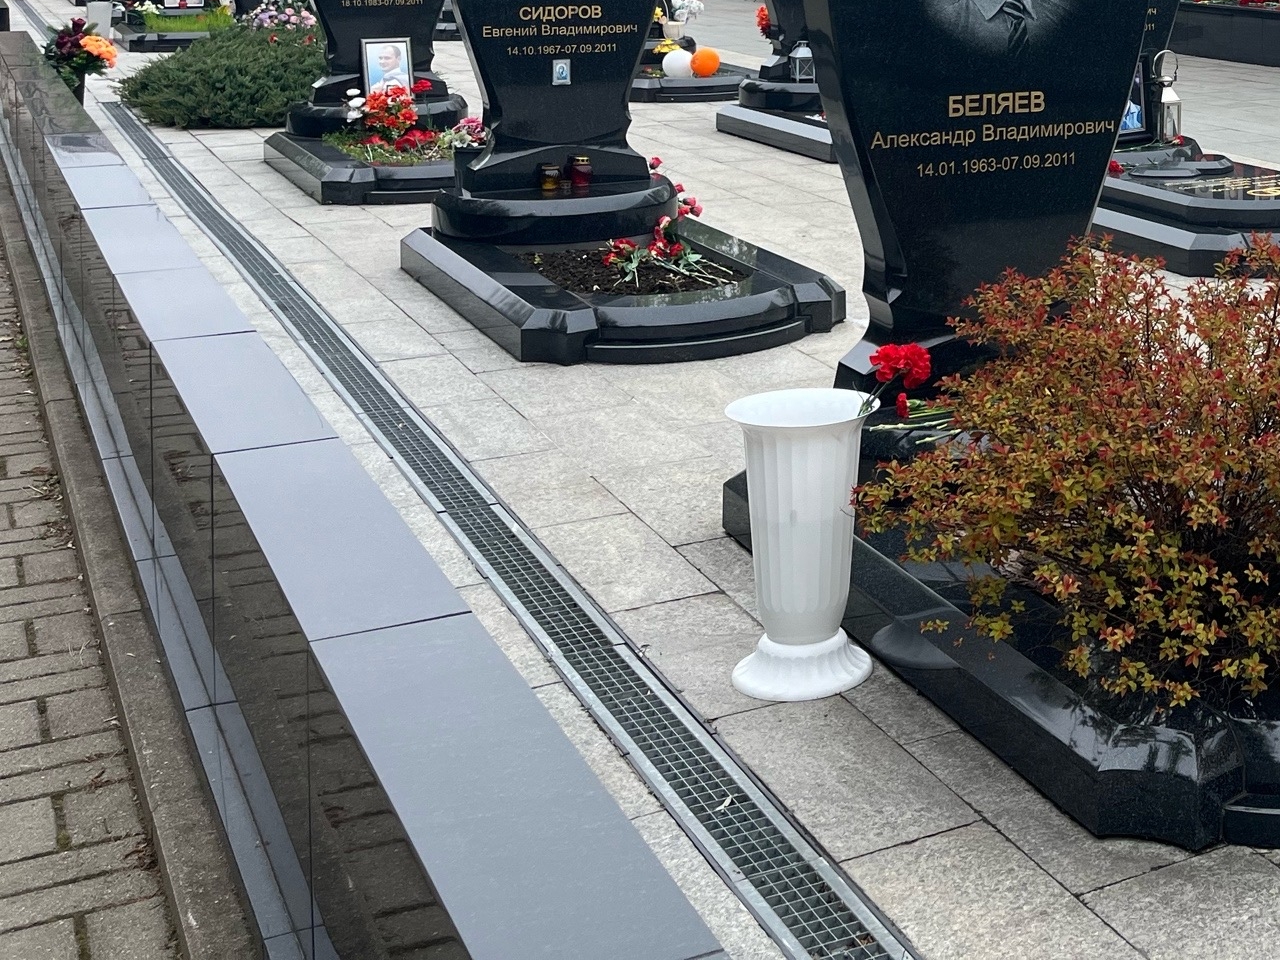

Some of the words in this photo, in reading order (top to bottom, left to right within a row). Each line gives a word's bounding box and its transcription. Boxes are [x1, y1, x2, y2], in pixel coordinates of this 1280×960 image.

[519, 5, 602, 22] СИДОРОВ
[482, 25, 537, 38] Евгений
[541, 24, 638, 37] Владимирович
[506, 43, 617, 56] 14.10.1967-07.09.2011
[948, 90, 1046, 117] БЕЛЯЕВ
[870, 128, 976, 150] Александр
[982, 119, 1115, 142] Владимирович
[917, 152, 1076, 178] 14.01.1963-07.09.2011
